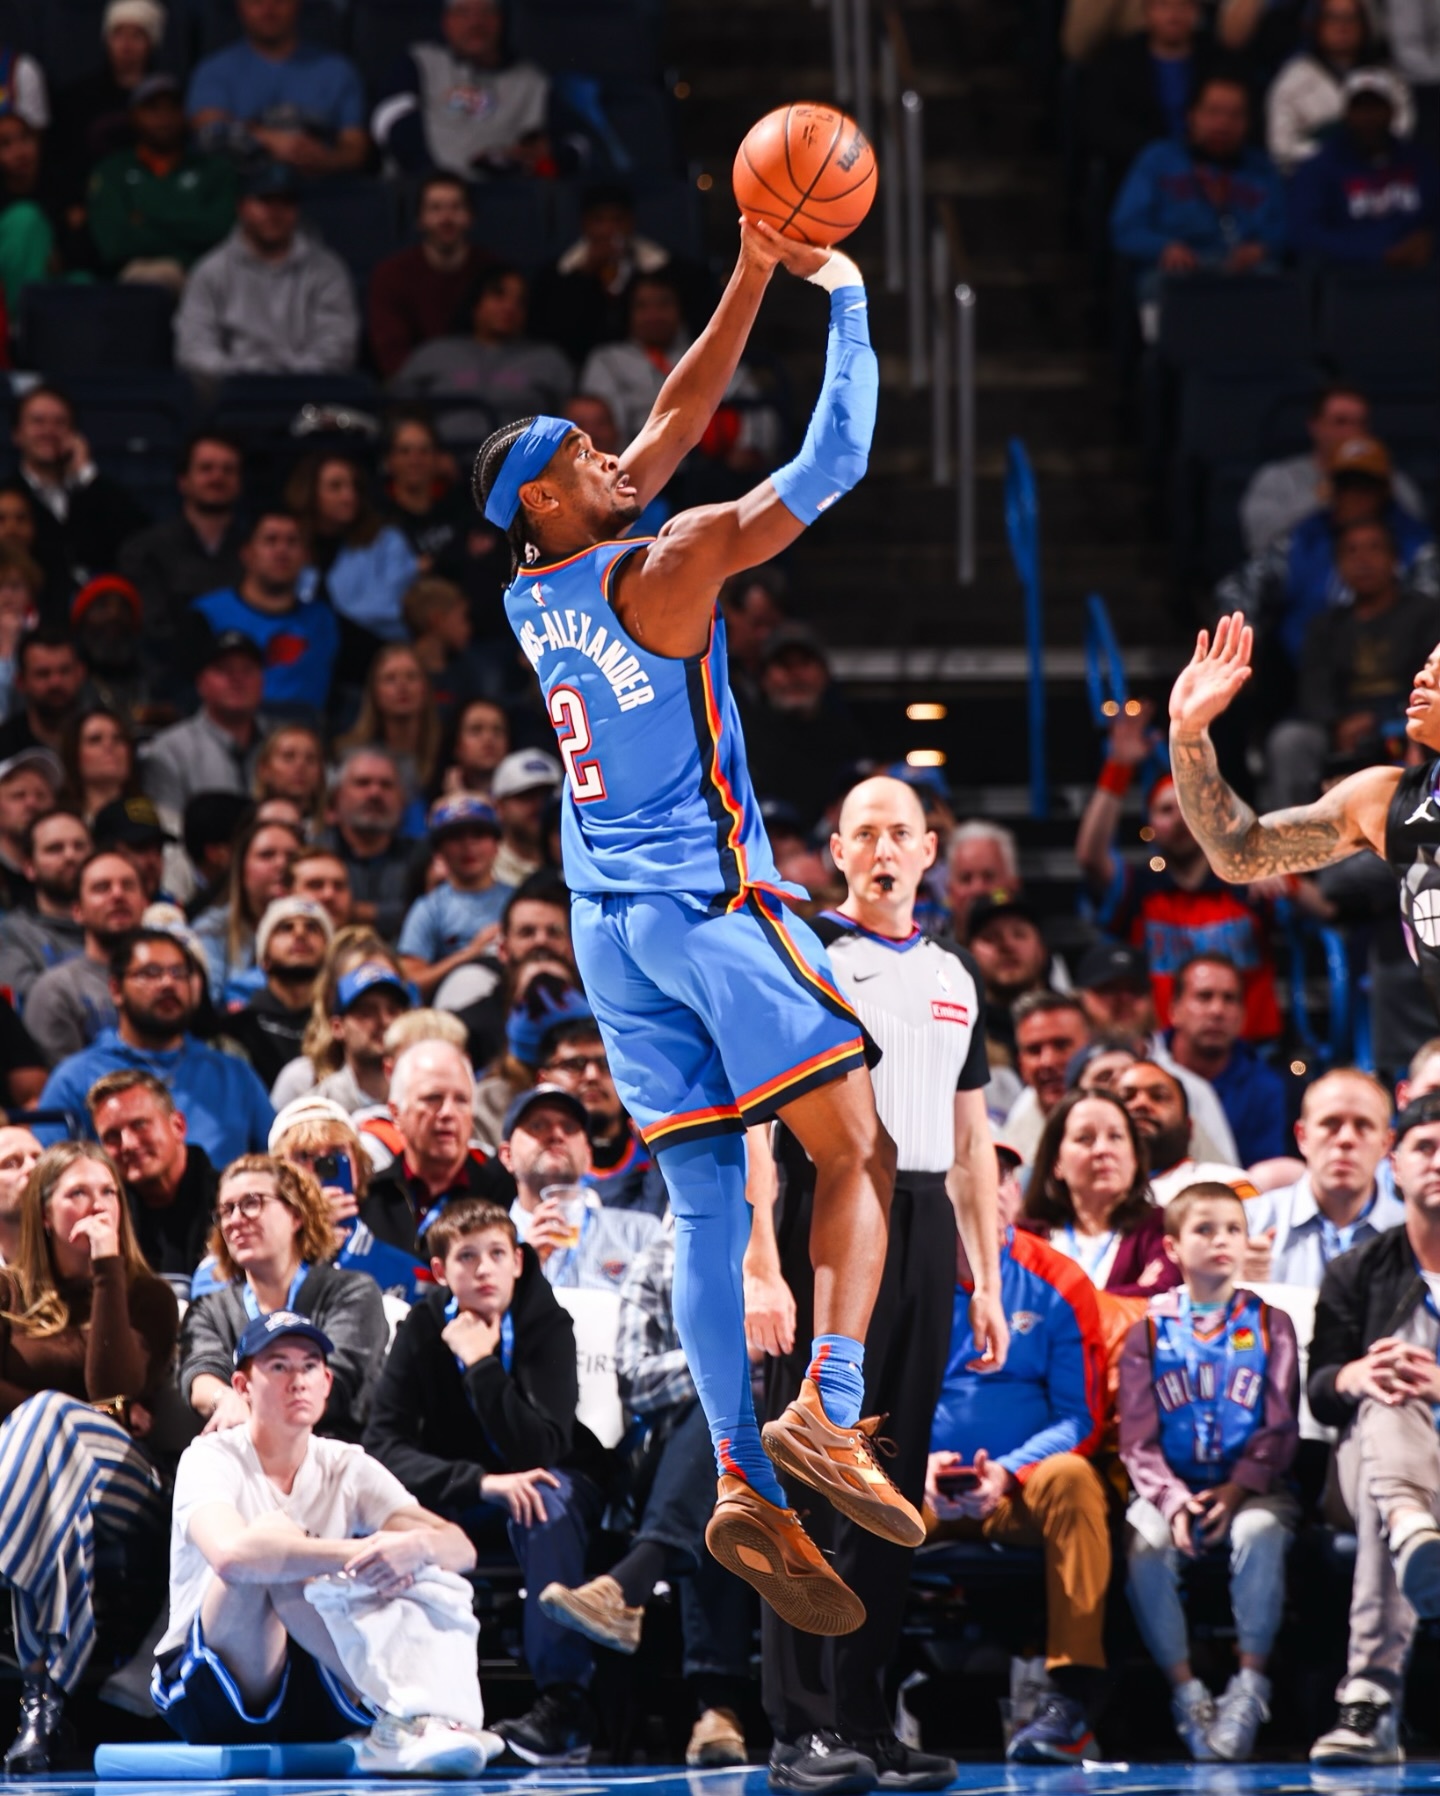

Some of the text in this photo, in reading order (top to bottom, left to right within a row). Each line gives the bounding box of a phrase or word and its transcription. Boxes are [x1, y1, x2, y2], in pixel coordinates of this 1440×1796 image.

[519, 609, 656, 713] US-ALEXANDER
[547, 683, 608, 804] 2
[577, 1351, 617, 1374] FIR
[1155, 1363, 1263, 1412] THUNER
